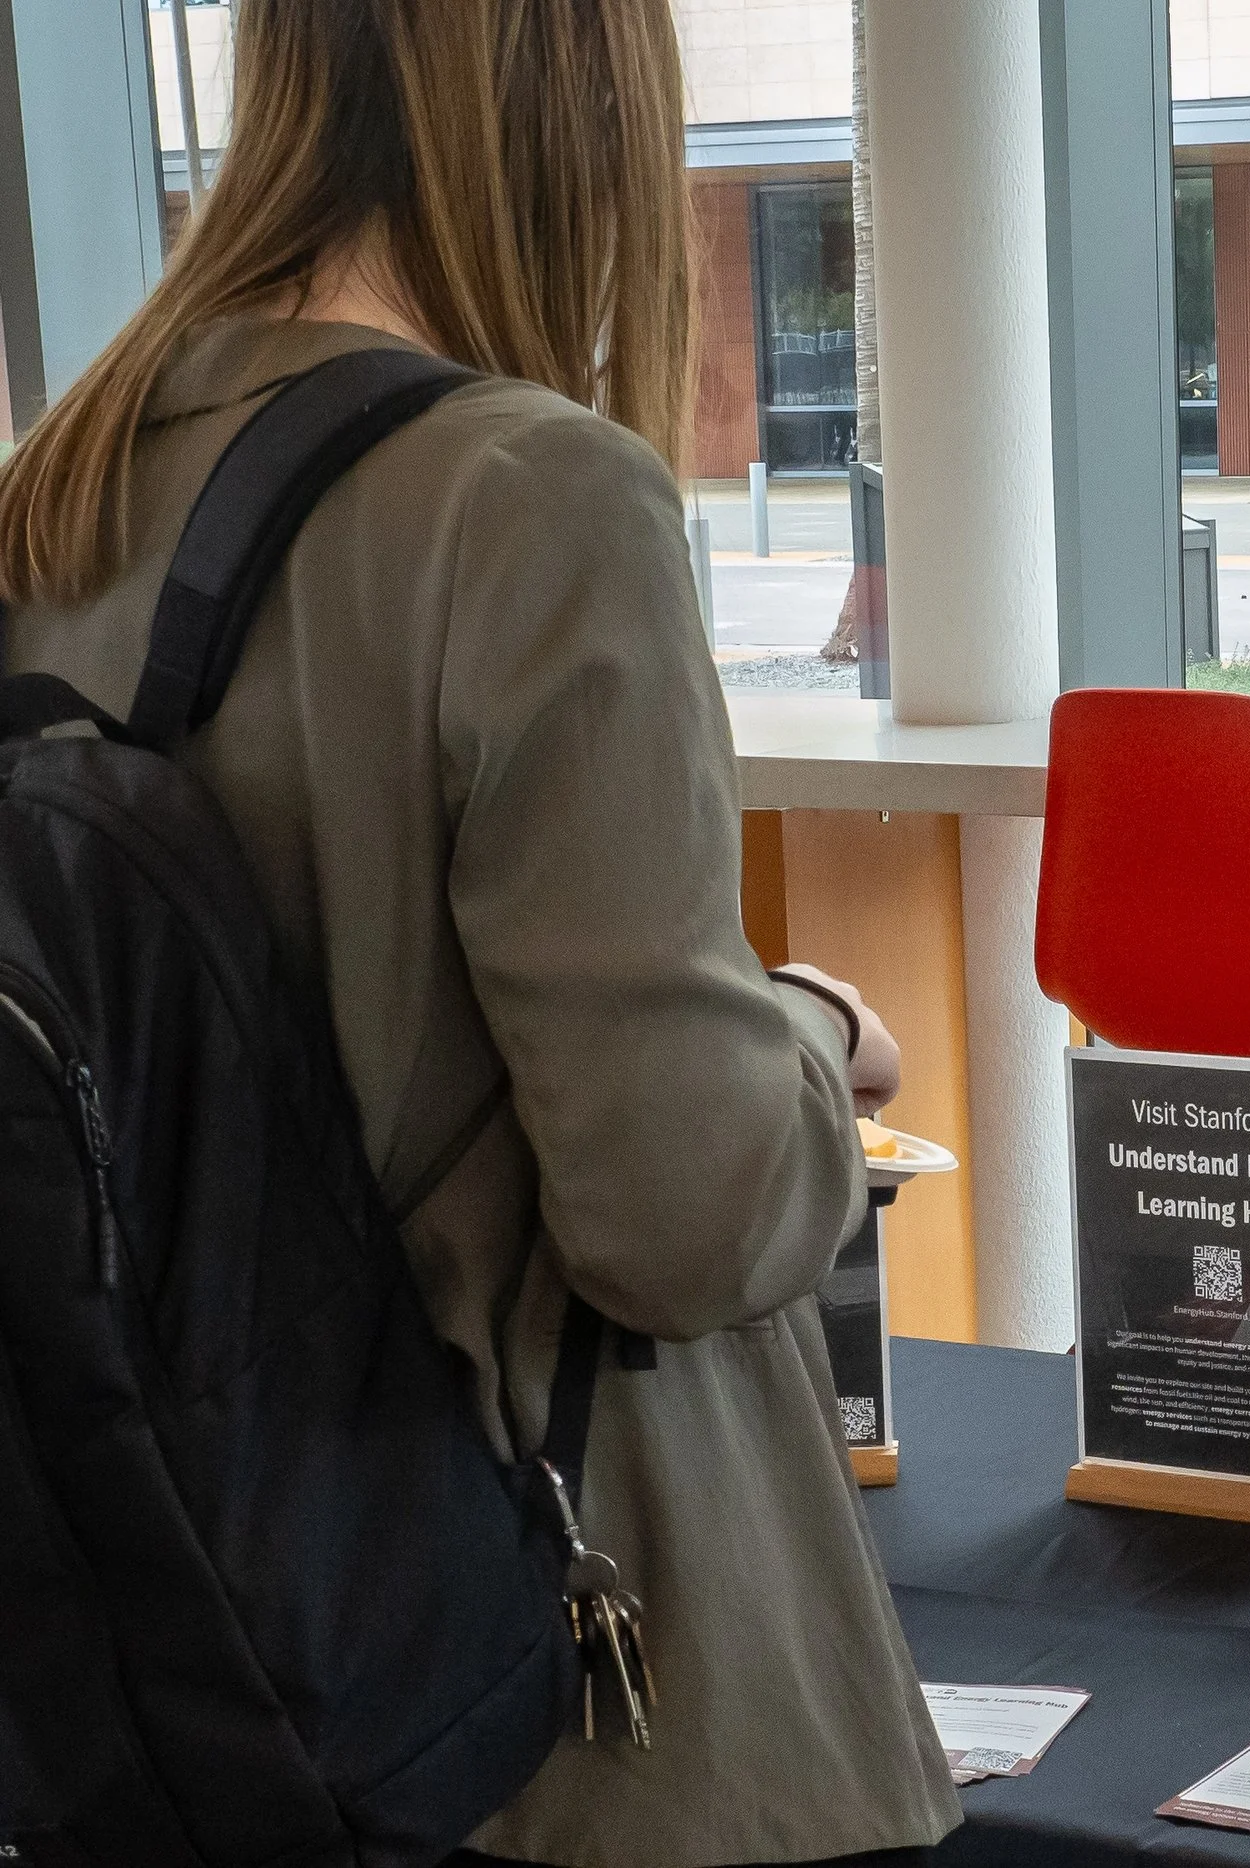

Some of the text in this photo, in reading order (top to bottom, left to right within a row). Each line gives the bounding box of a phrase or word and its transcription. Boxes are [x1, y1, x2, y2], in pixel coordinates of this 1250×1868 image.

[1132, 1099, 1178, 1126] Visit
[1109, 1143, 1239, 1177] Understand
[1138, 1190, 1235, 1228] Learning
